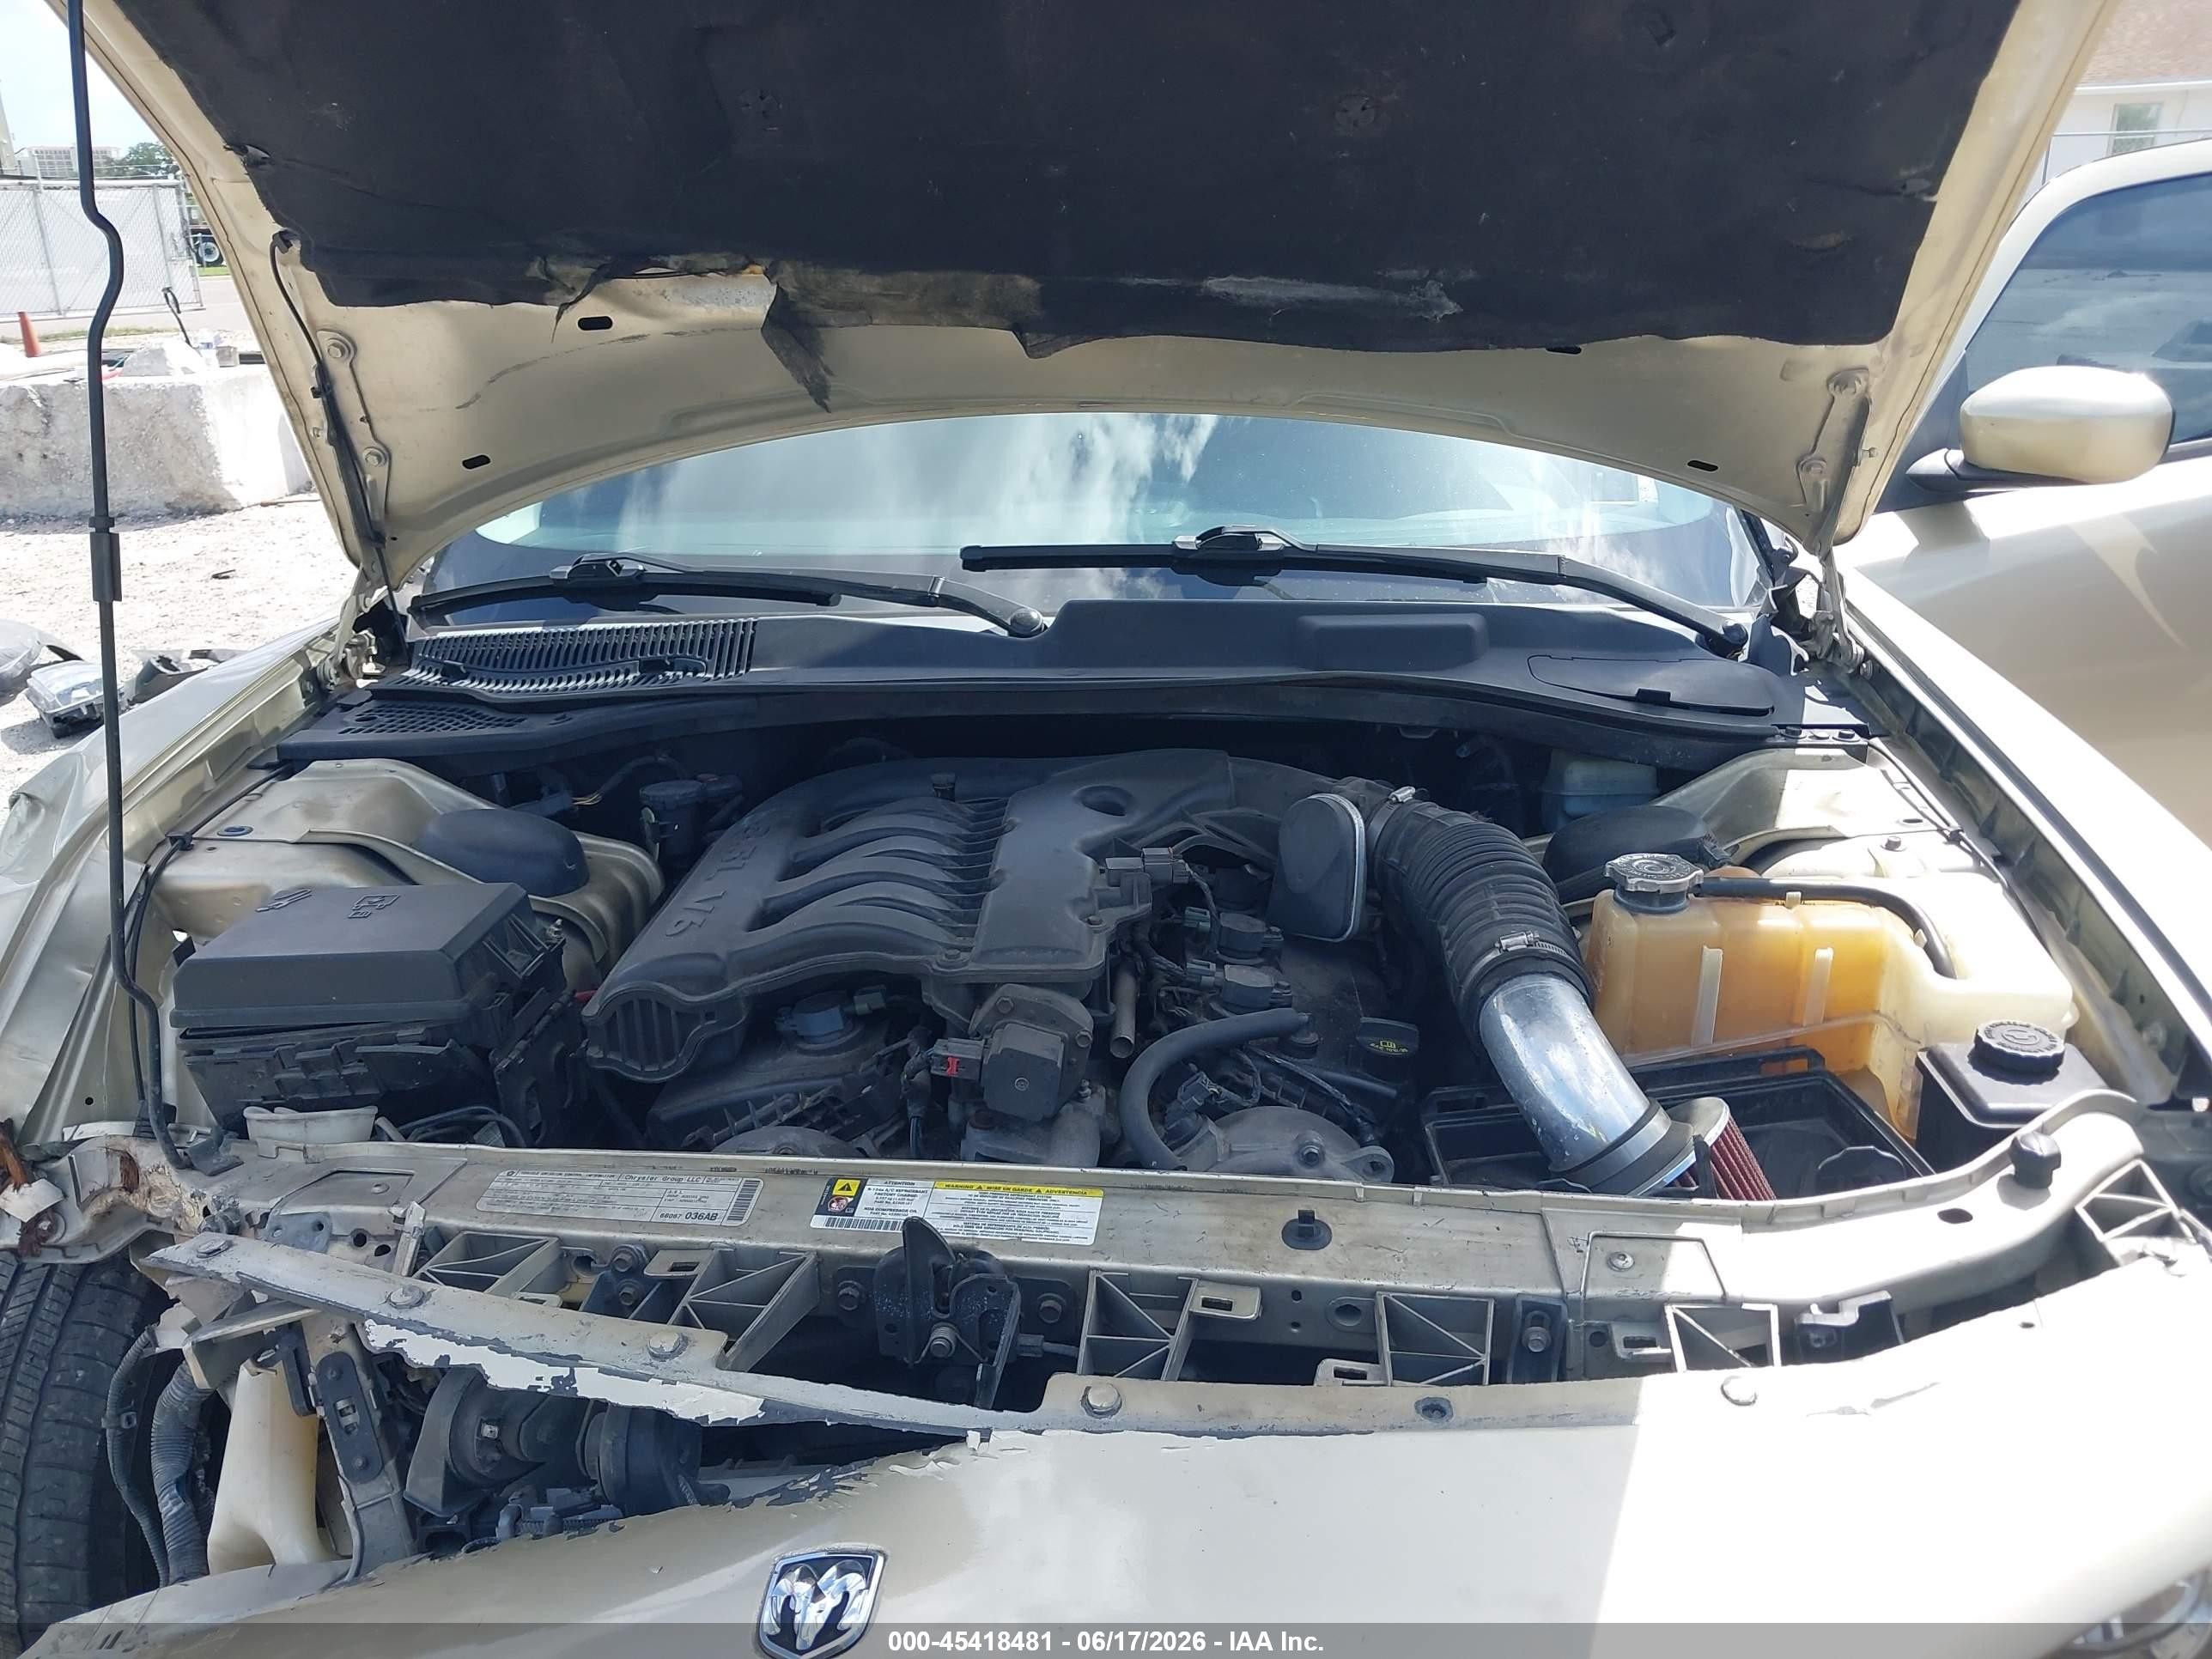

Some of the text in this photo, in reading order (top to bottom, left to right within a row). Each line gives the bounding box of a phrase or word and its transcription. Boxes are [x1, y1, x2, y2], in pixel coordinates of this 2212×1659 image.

[624, 1174, 659, 1182] Chrysler
[662, 1175, 684, 1183] Group
[685, 1212, 718, 1221] 036AB
